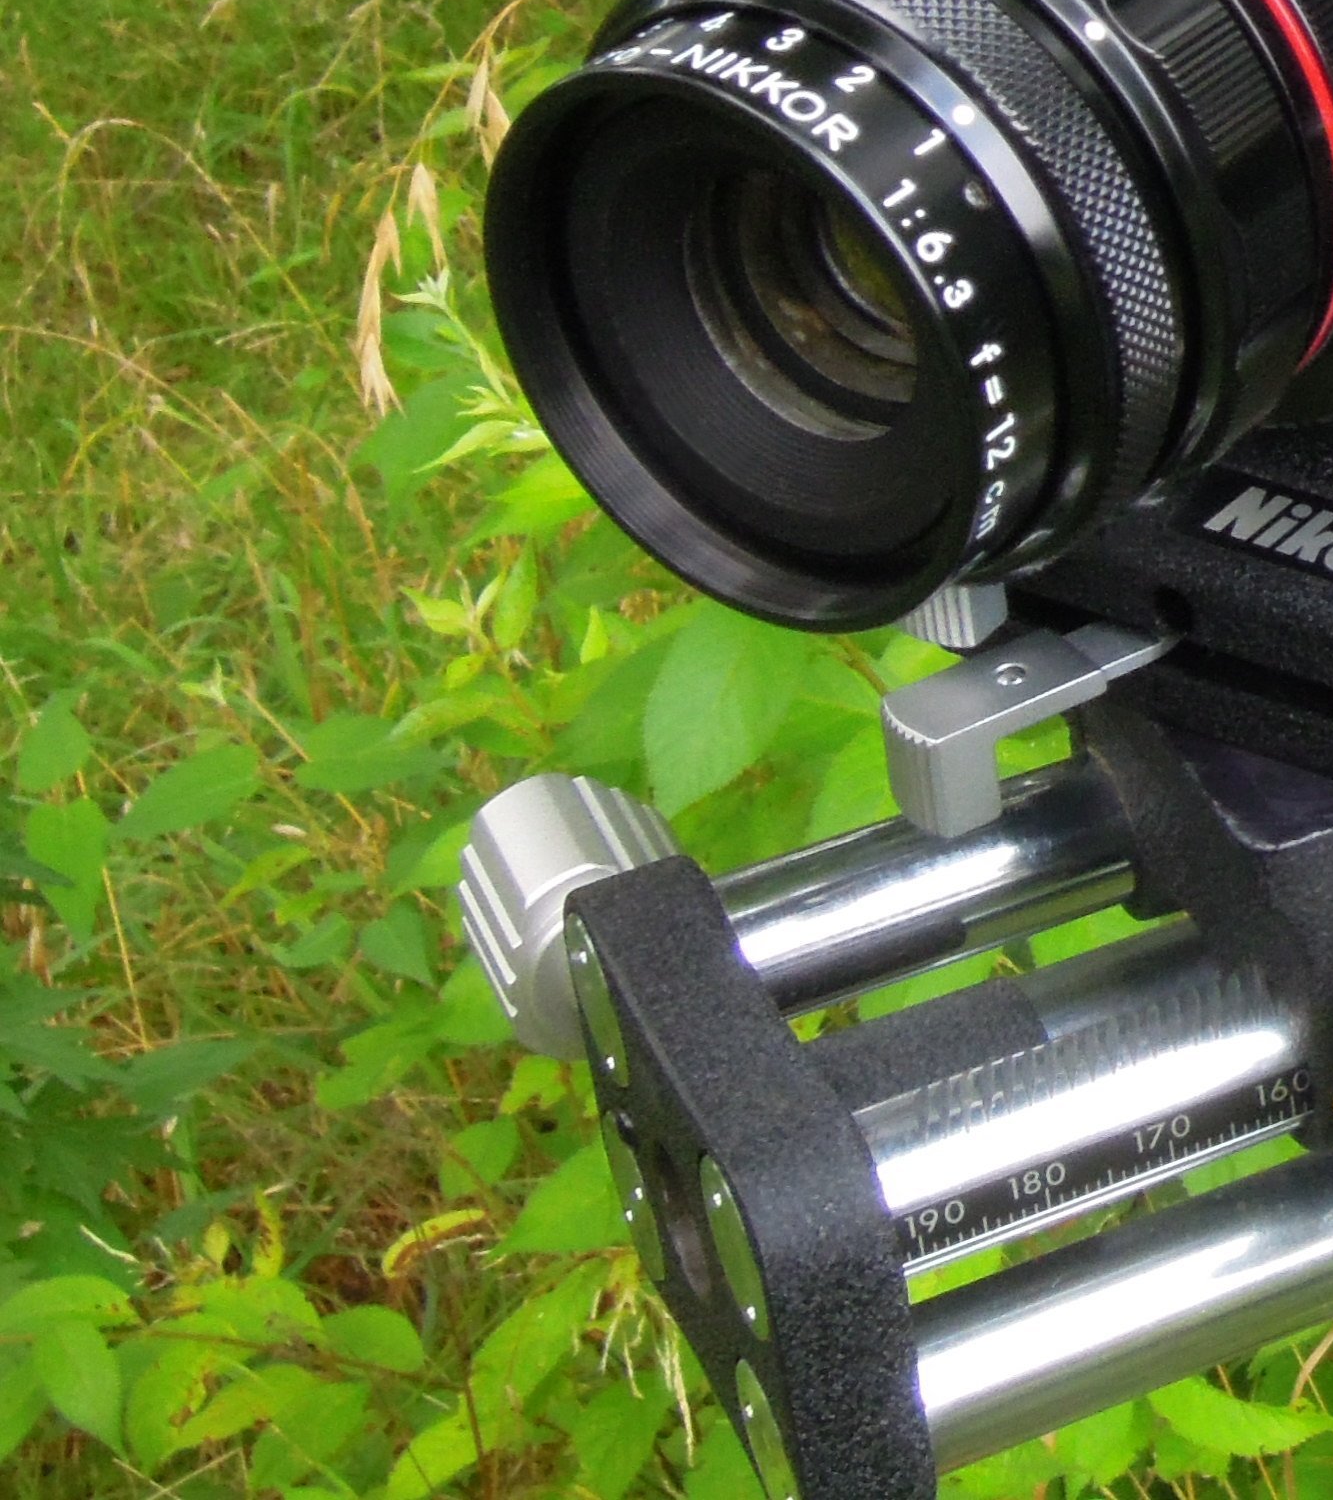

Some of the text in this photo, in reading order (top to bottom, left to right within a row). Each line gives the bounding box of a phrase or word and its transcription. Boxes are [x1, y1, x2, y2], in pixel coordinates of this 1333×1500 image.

[700, 11, 735, 33] 4
[765, 28, 805, 52] 3
[834, 65, 876, 93] 2
[913, 128, 946, 156] 1
[882, 178, 974, 309] 1:6.3
[904, 1069, 1310, 1239] 190 180 170 160
